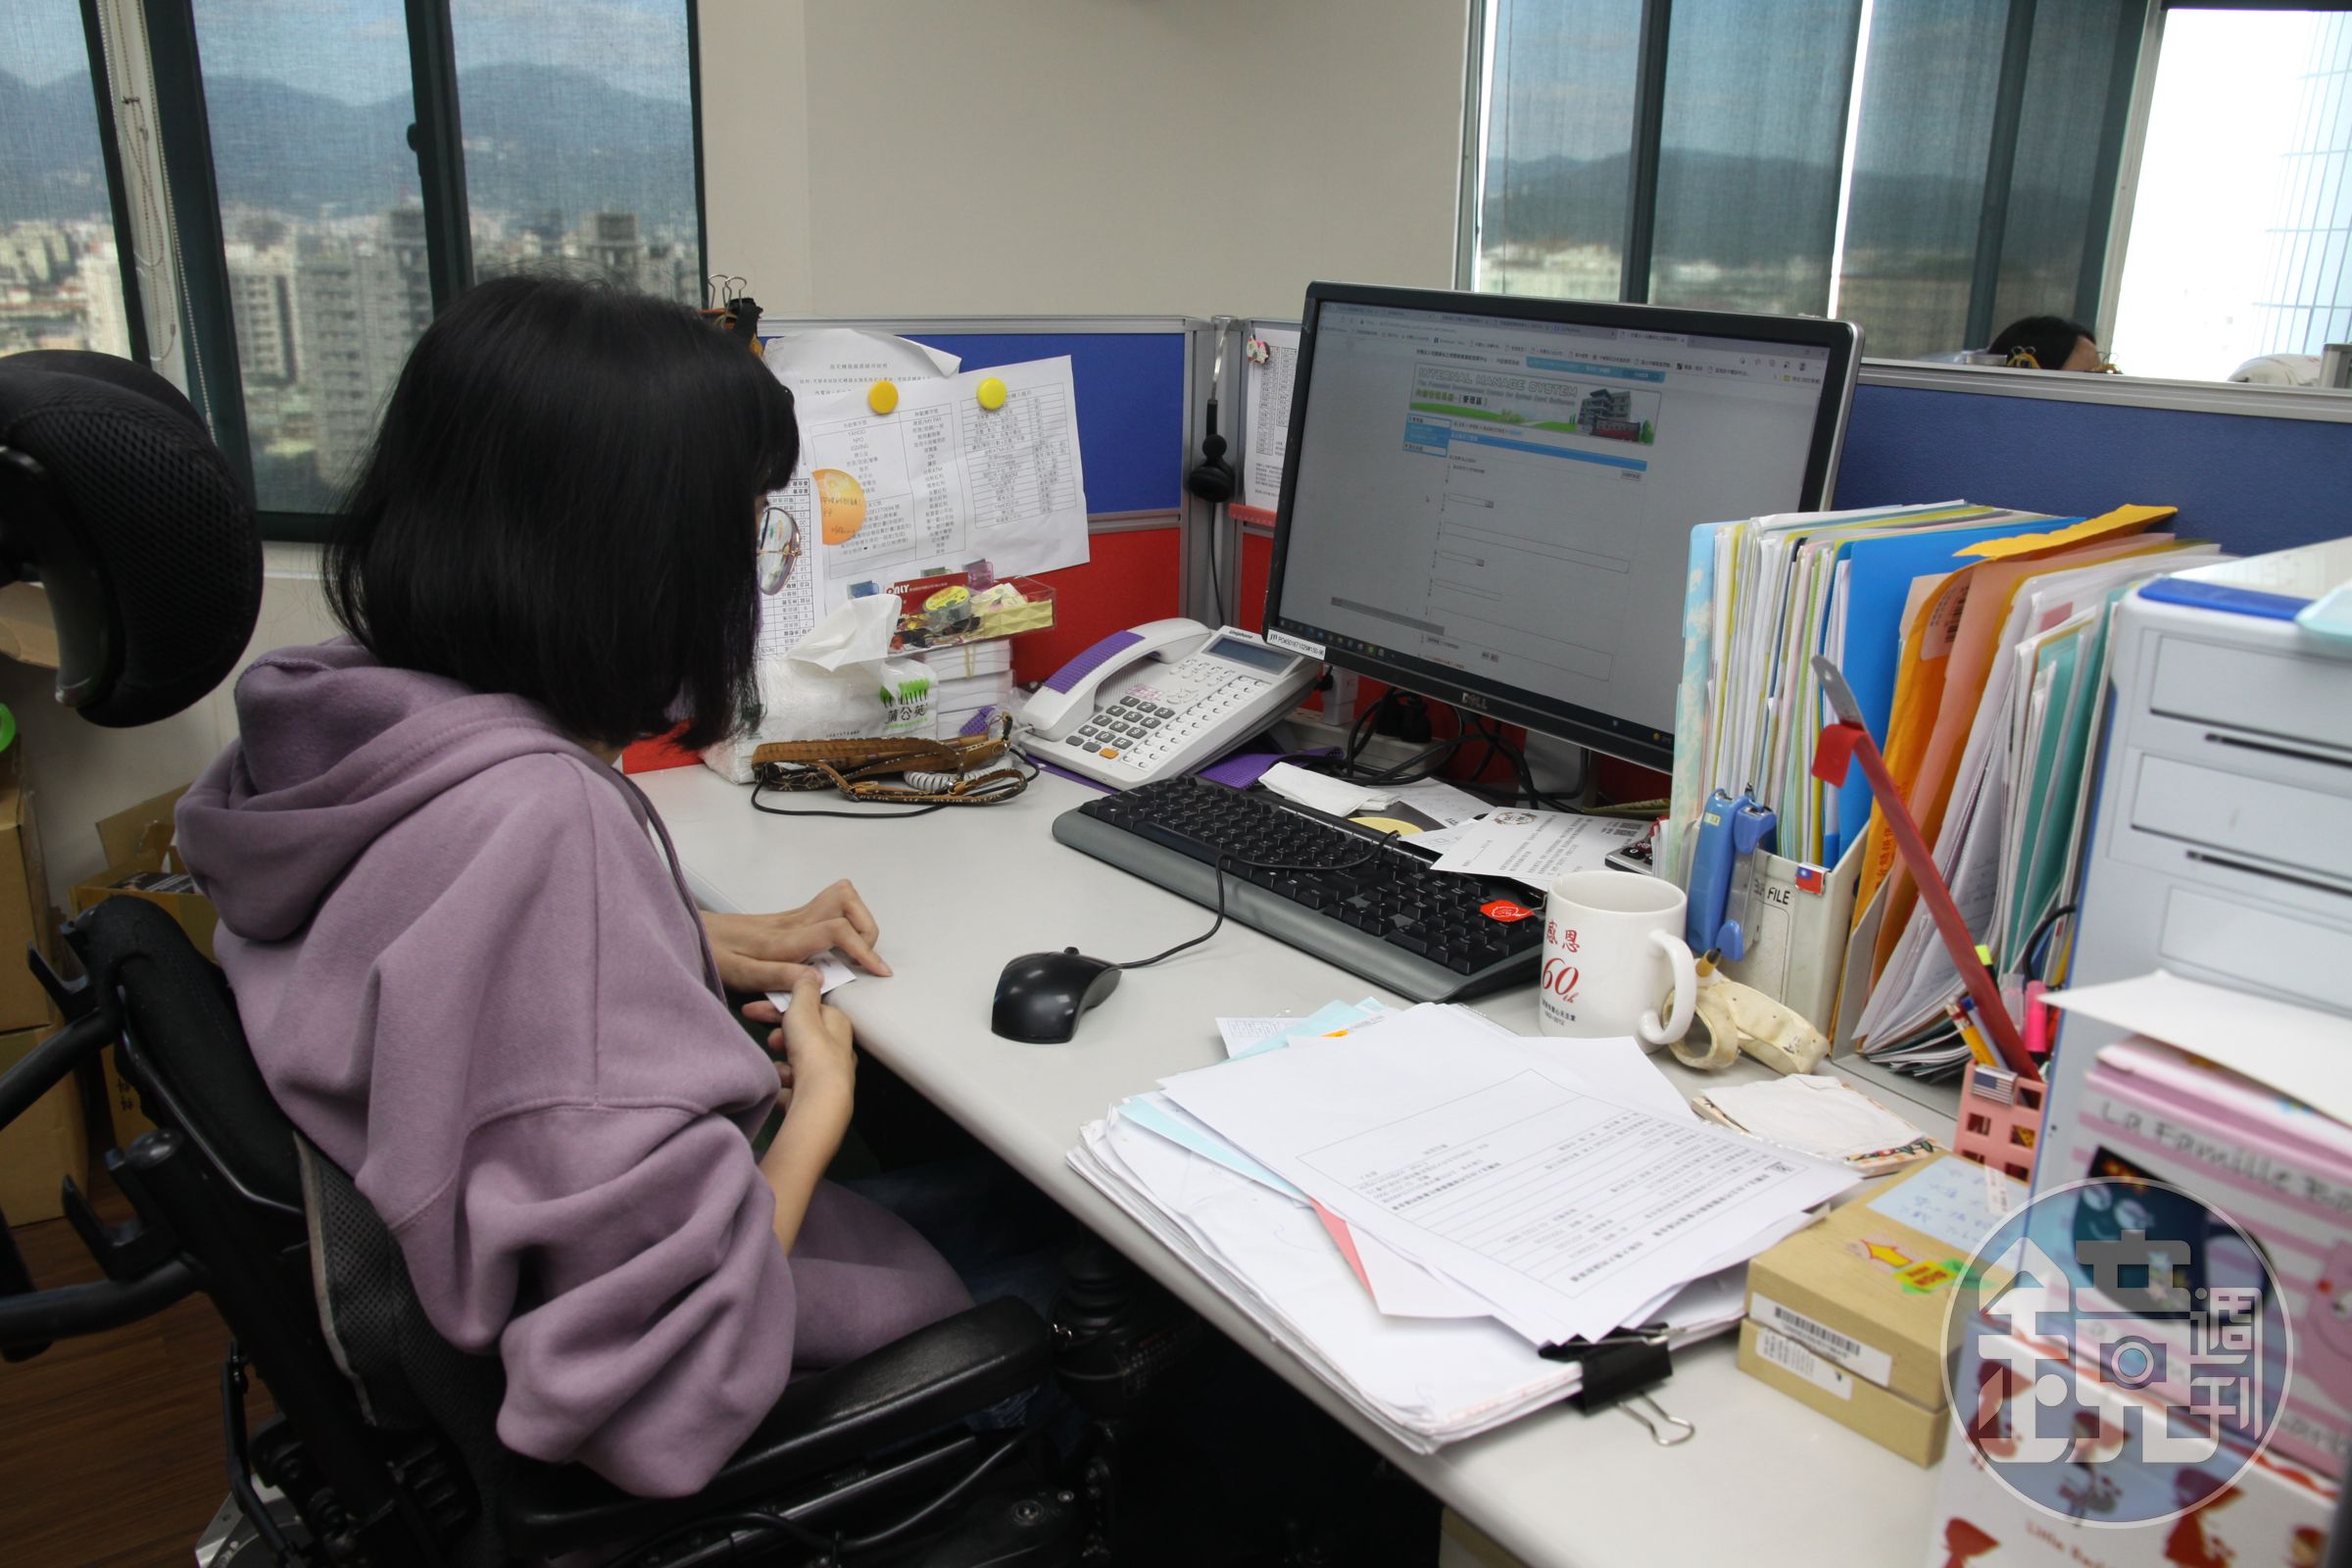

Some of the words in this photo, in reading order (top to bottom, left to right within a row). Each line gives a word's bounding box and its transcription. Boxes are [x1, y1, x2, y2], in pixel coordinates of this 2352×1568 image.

[1476, 374, 1525, 391] MANAGE
[1528, 380, 1578, 398] SYSTEM
[1767, 887, 1790, 905] FILE
